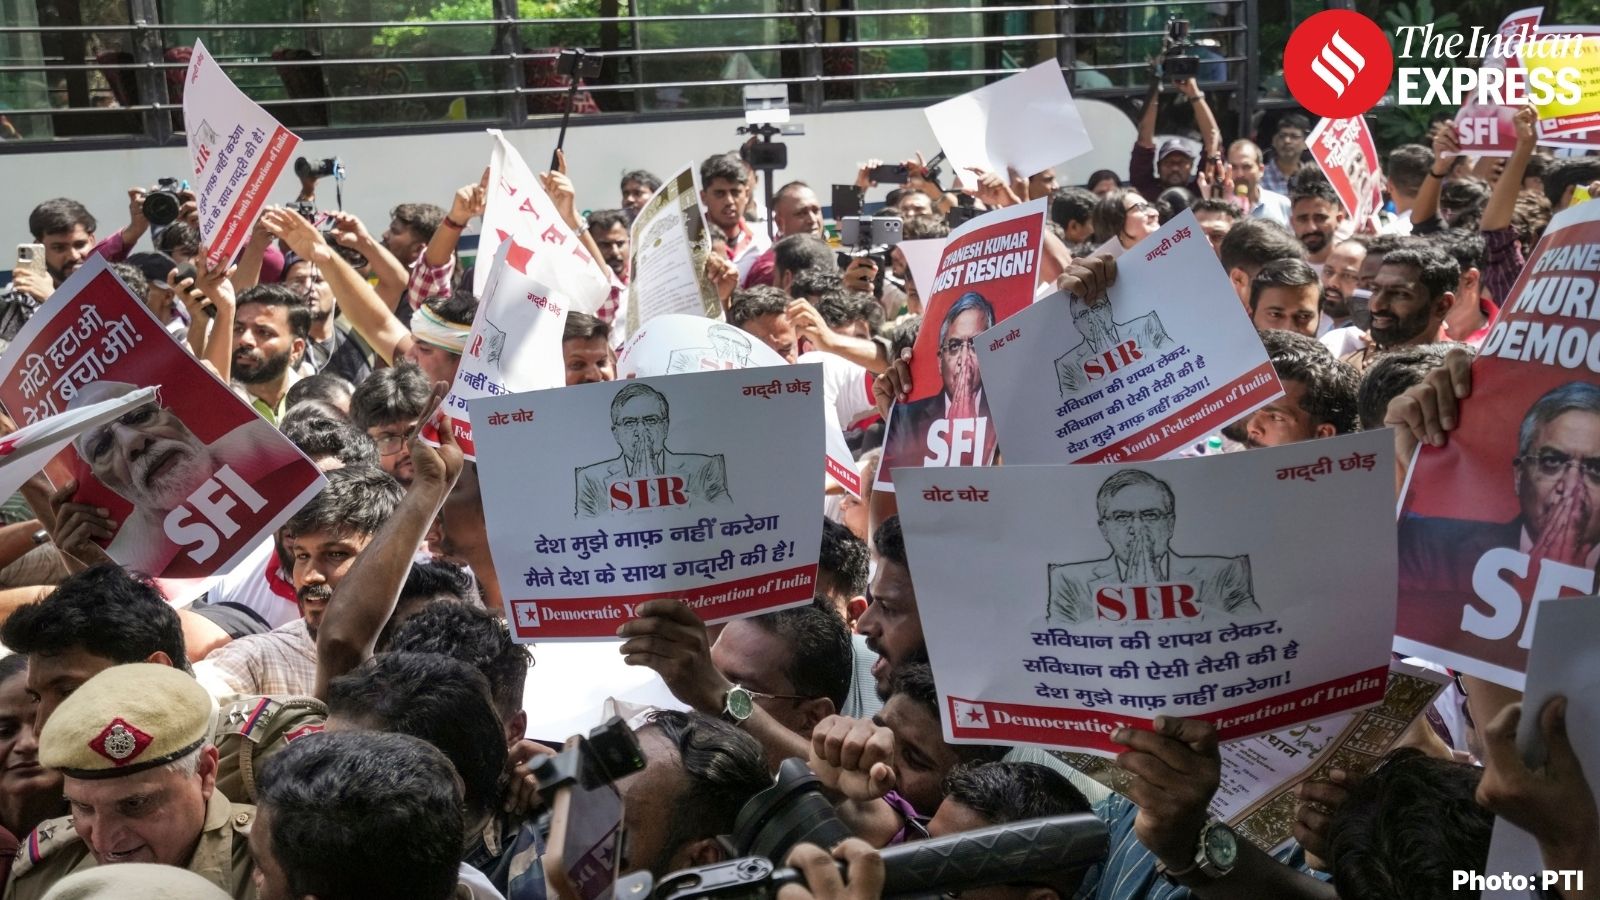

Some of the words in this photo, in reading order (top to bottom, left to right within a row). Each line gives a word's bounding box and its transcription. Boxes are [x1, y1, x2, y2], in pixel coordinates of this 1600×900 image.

[1458, 117, 1499, 145] SFI
[245, 161, 272, 203] Federation
[984, 230, 1029, 255] KUMAR
[1145, 237, 1173, 263] गद्दी
[1171, 225, 1193, 245] छोड़
[964, 249, 1035, 285] RESIGN!
[527, 291, 548, 309] गद्दी
[45, 304, 104, 370] हटाओ
[52, 314, 143, 401] बचाओ!
[464, 371, 488, 391] नहीं
[1083, 339, 1144, 383] SIR
[742, 383, 782, 401] गद्दी
[785, 379, 812, 397] छोड़
[1055, 389, 1104, 419] संविधान
[1105, 377, 1125, 396] की
[1126, 364, 1156, 388] शपथ
[1055, 409, 1105, 440] संविधान
[1106, 399, 1125, 418] की
[1126, 385, 1151, 407] ऐसी
[1151, 373, 1176, 395] तैसी
[1177, 362, 1195, 381] की
[1194, 354, 1207, 371] है
[488, 411, 510, 426] वोट
[511, 408, 534, 422] चोर
[1066, 435, 1089, 455] देश
[1091, 424, 1116, 447] मुझे
[1146, 396, 1172, 419] नहीं
[1172, 376, 1211, 407] करेगा!
[1120, 429, 1161, 457] Youth
[1161, 397, 1225, 437] Federation
[1224, 387, 1239, 405] of
[1238, 370, 1273, 398] India
[924, 416, 988, 468] SFI
[828, 458, 857, 486] India
[1276, 461, 1333, 482] गद्दी
[1338, 452, 1378, 473] छोड़
[609, 474, 689, 512] SIR
[922, 485, 954, 504] वोट
[957, 485, 990, 504] चोर
[163, 463, 269, 565] SFI
[534, 534, 567, 555] देश
[570, 529, 608, 560] मुझे
[614, 528, 663, 549] माफ़
[670, 518, 718, 543] नहीं
[719, 513, 780, 538] करेगा
[523, 567, 555, 588] मैने
[558, 566, 590, 586] देश
[595, 563, 617, 585] के
[622, 562, 667, 583] साथ
[740, 543, 768, 567] की
[771, 540, 795, 563] है!
[542, 603, 622, 622] Democratic
[757, 580, 775, 596] of
[774, 573, 812, 592] India
[1095, 583, 1201, 623] SIR
[1031, 627, 1113, 651] संविधान
[1119, 630, 1151, 651] की
[1157, 629, 1212, 650] शपथ
[1218, 619, 1283, 645] लेकर,
[1022, 656, 1103, 678] संविधान
[1108, 659, 1140, 680] की
[1146, 656, 1190, 681] ऐसी
[1195, 651, 1240, 676] तैसी
[1246, 647, 1277, 669] की
[1281, 639, 1300, 661] है
[992, 709, 1113, 734] Democratic
[1214, 701, 1297, 730] eration
[1300, 692, 1324, 710] of
[1324, 675, 1381, 701] India
[1035, 681, 1069, 701] देश
[1074, 685, 1114, 707] मुझे
[1119, 689, 1168, 711] माफ़
[1173, 682, 1218, 706] नहीं
[1222, 671, 1291, 700] करेगा!
